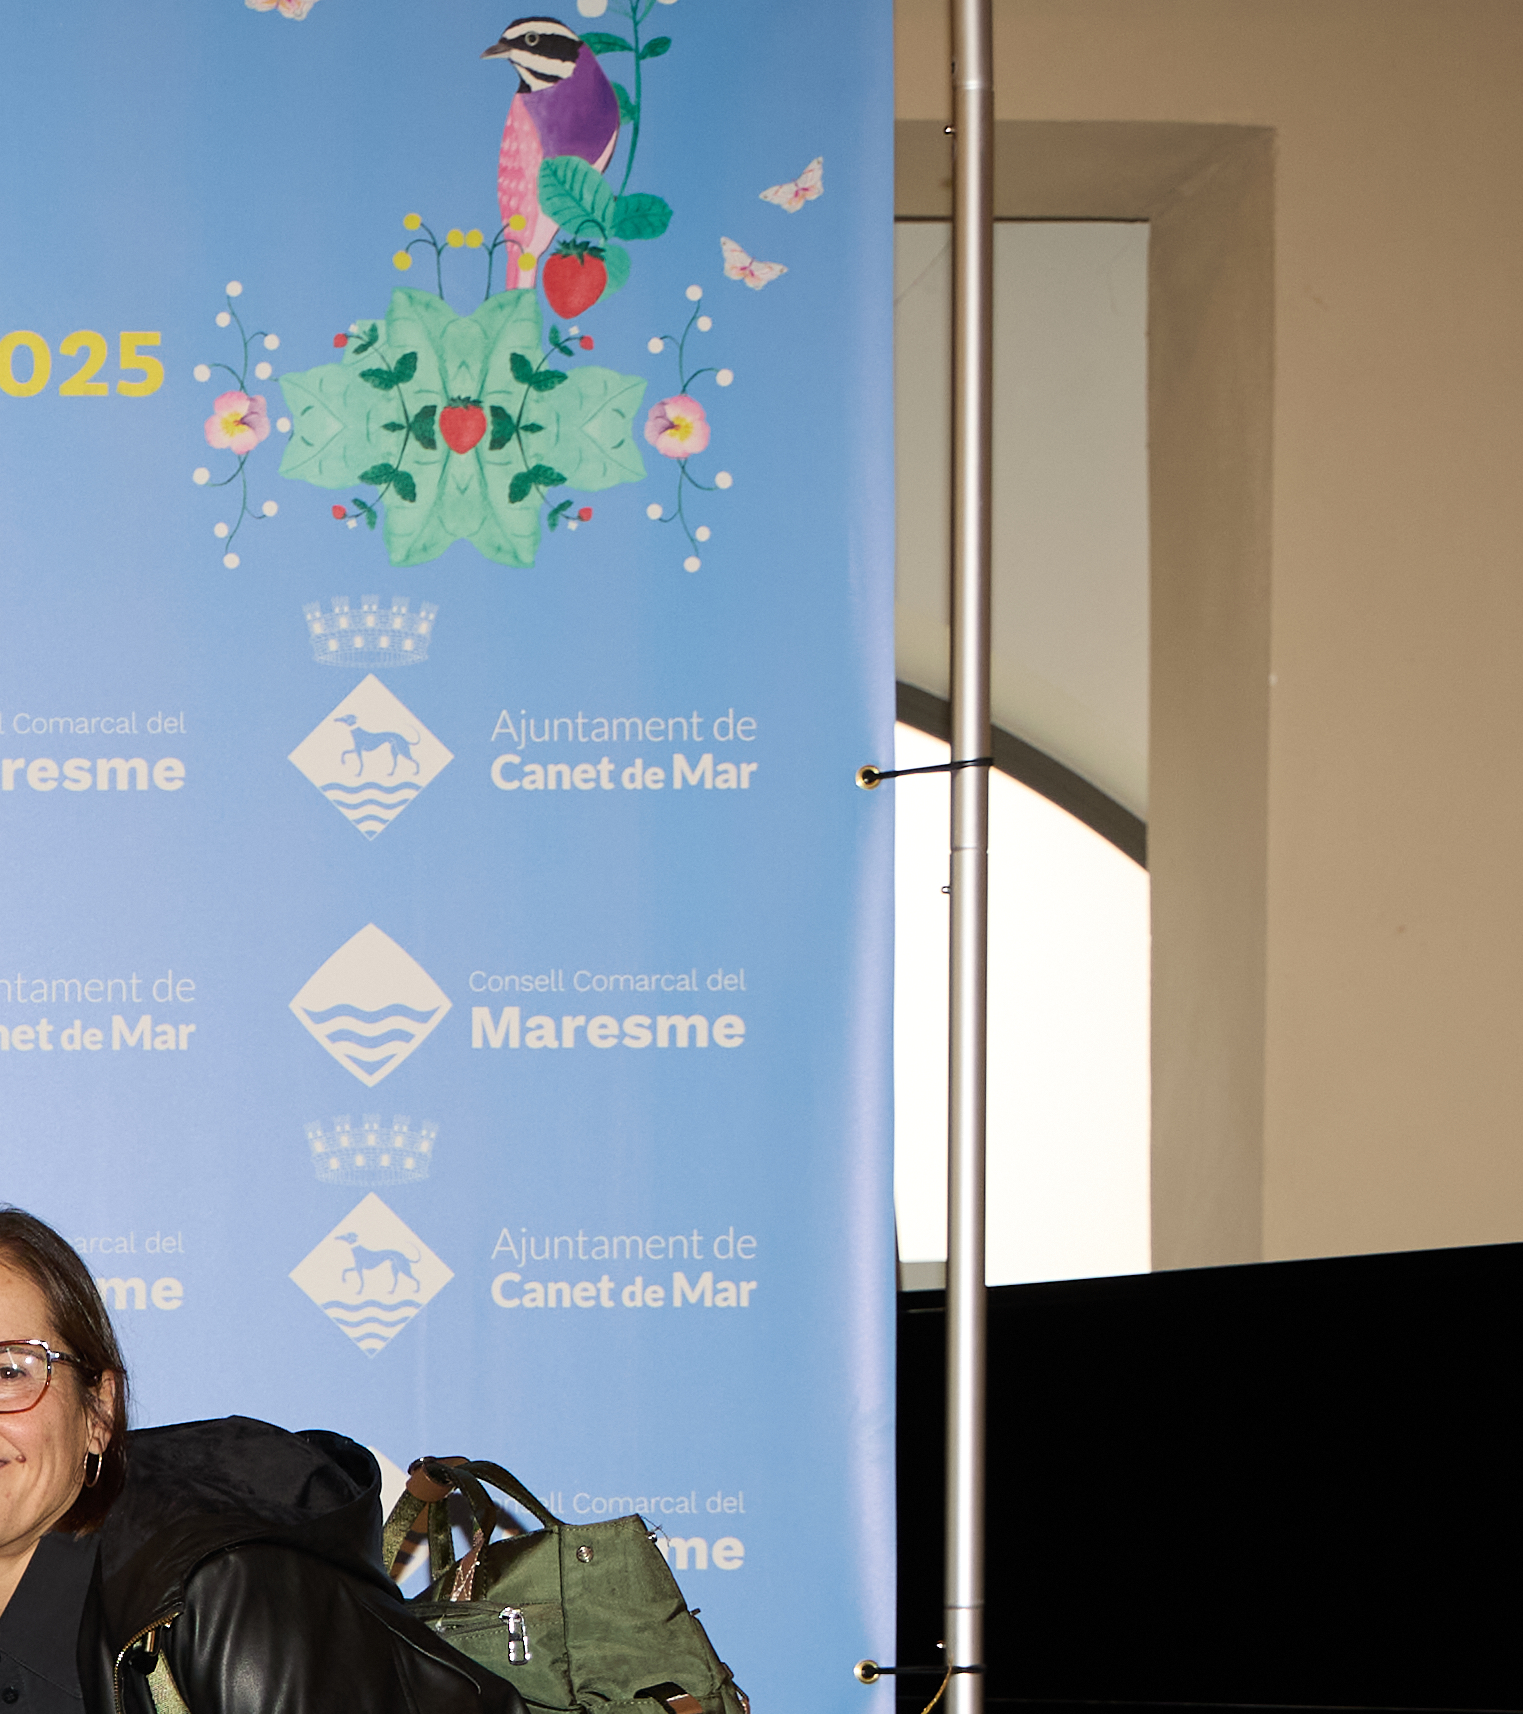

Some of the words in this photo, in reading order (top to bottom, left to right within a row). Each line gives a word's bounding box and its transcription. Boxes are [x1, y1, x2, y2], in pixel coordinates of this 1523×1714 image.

[13, 712, 137, 734] Comarcal
[147, 712, 184, 734] del
[491, 710, 703, 749] Ajuntament
[713, 708, 757, 741] de
[491, 753, 615, 790] Canet
[621, 758, 665, 790] de
[673, 753, 759, 789] Mar
[469, 969, 564, 991] Consell
[574, 969, 697, 991] Comarcal
[707, 969, 744, 991] del
[472, 1006, 746, 1049] Maresme
[145, 1231, 184, 1254] del
[492, 1228, 703, 1266] Ajuntament
[713, 1226, 757, 1259] de
[491, 1271, 615, 1308] Canet
[621, 1276, 665, 1308] de
[673, 1271, 758, 1308] Mar
[573, 1492, 697, 1515] Comarcal
[706, 1491, 745, 1514] del
